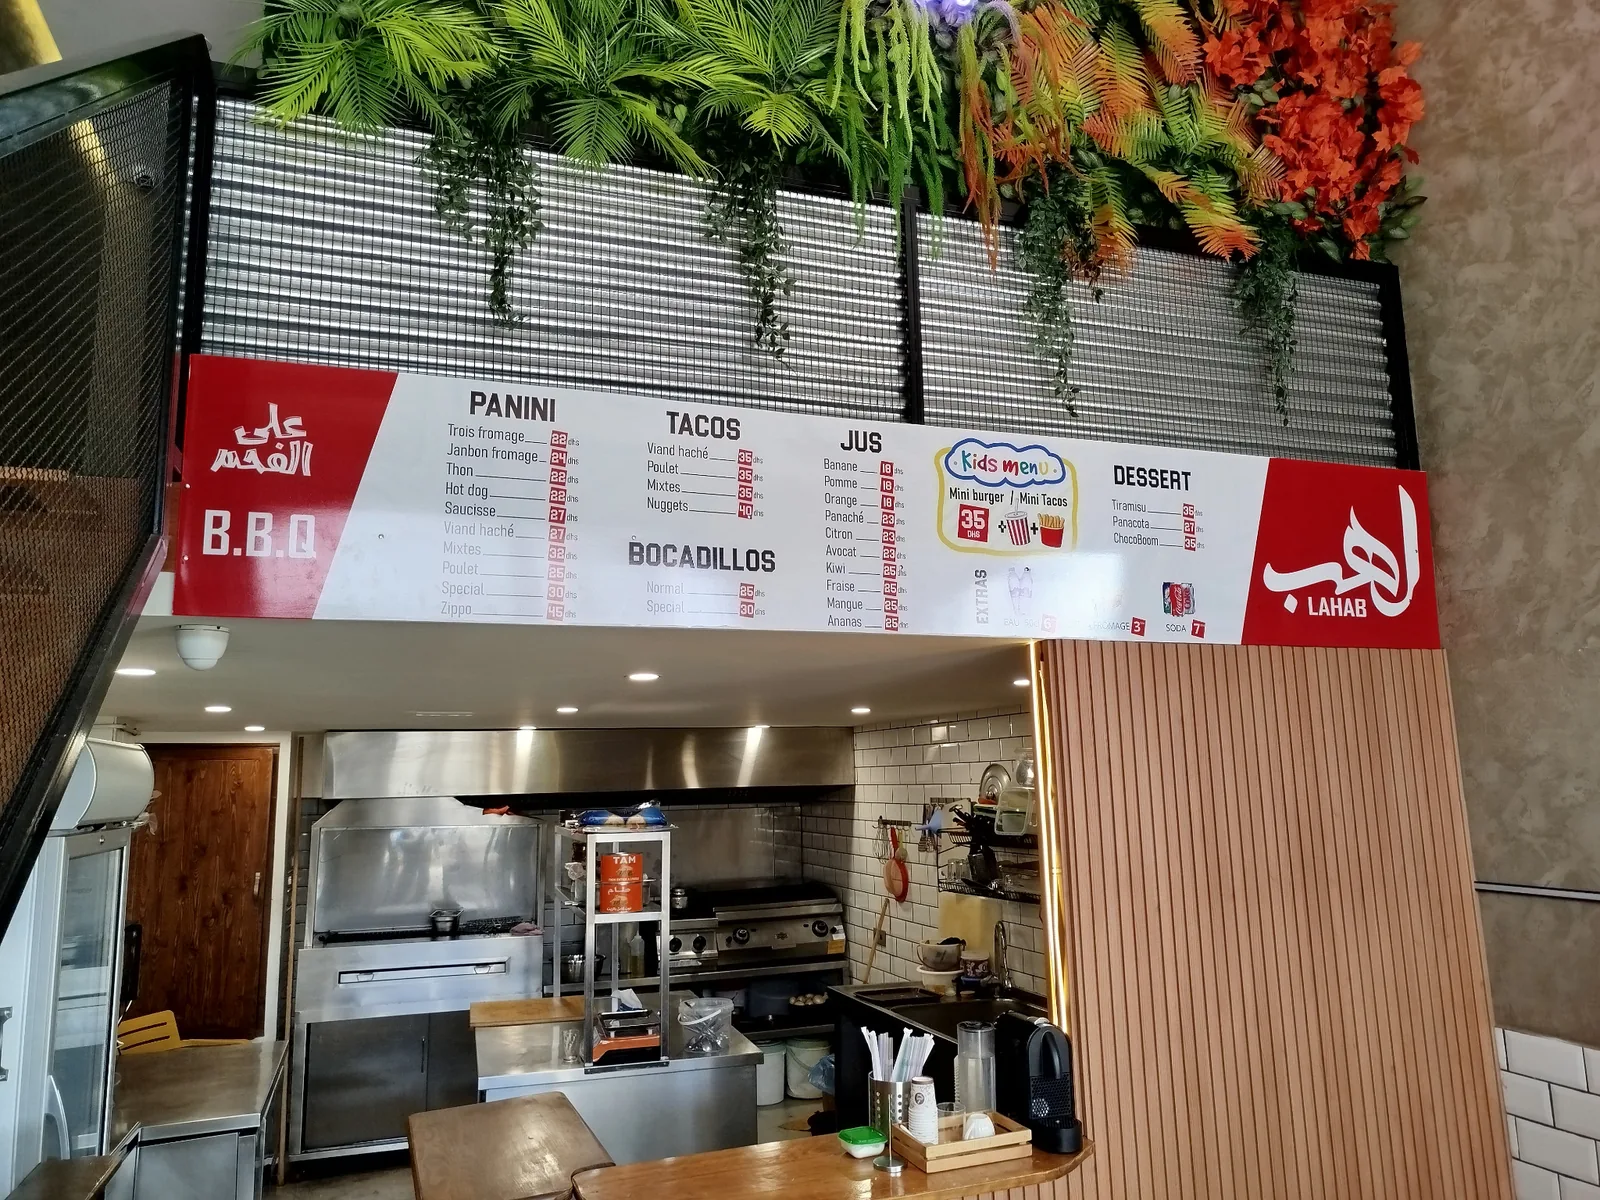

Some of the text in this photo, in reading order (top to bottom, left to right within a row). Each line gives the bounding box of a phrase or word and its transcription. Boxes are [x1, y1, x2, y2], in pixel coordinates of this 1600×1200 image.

[469, 390, 556, 422] PANINI
[232, 402, 306, 445] على
[666, 411, 740, 440] TACOS
[448, 424, 475, 438] Trois
[478, 426, 525, 444] fromage
[551, 434, 567, 445] 22
[840, 430, 882, 454] JUS
[210, 440, 313, 476] الفحم
[447, 444, 579, 465] Janbon fromage 24 dhs
[647, 442, 675, 456] Viand
[678, 447, 708, 459] haché
[738, 452, 752, 462] 35
[961, 450, 997, 473] Kids
[446, 463, 579, 484] Thon 22 dhs
[647, 461, 763, 482] Poulet 35 dhs
[823, 458, 857, 472] Banane
[882, 464, 891, 473] 18
[824, 476, 857, 489] Pomme
[883, 481, 892, 490] 18
[1114, 465, 1191, 491] DESSERT
[446, 483, 578, 503] Hot dog 22 dhs
[647, 479, 680, 492] Mixtes
[739, 488, 752, 498] 35
[949, 487, 970, 500] Mini
[973, 489, 1005, 505] burger
[1020, 492, 1039, 505] Mini
[1041, 494, 1068, 507] Tacos
[647, 497, 688, 513] Nuggets
[739, 505, 752, 516] 40
[825, 493, 857, 509] Orange
[884, 498, 892, 507] 18
[1112, 499, 1146, 512] Tiramisu
[1183, 506, 1194, 515] 35
[445, 502, 578, 522] Saucisse 27 dhs
[825, 510, 864, 524] Panaché
[883, 515, 894, 524] 23
[961, 509, 985, 530] 35
[202, 509, 317, 558] B.B.Q
[444, 522, 578, 541] Viand haché 27 dhs
[1113, 516, 1149, 529] Panacota
[1184, 522, 1195, 532] 27
[825, 527, 853, 540] Citron
[883, 532, 895, 542] 23
[967, 530, 980, 539] DHS
[1114, 533, 1159, 546] ChocoBoom
[1185, 539, 1195, 549] 35
[443, 541, 577, 560] Mixtes 32 dhs
[628, 542, 776, 572] BOCADILLOS
[826, 545, 856, 557] Avocat
[883, 549, 895, 558] 23
[1263, 485, 1420, 617] لهب
[442, 561, 577, 580] Poulet 25 dhs
[826, 562, 846, 574] Kiwi
[884, 566, 896, 576] 25
[441, 582, 577, 599] Special 30 dhs
[646, 581, 685, 594] Normal
[827, 579, 854, 592] Fraise
[884, 583, 896, 593] 25
[827, 597, 863, 612] Mangue
[885, 601, 897, 610] 25
[975, 569, 988, 624] EXTRAS
[440, 602, 472, 617] Zippo
[548, 606, 563, 618] 45
[646, 600, 685, 614] Special
[740, 605, 754, 615] 30
[1308, 597, 1367, 617] LAHAB
[828, 614, 862, 627] Ananas
[886, 618, 898, 627] 25
[1134, 622, 1140, 631] 3
[1166, 624, 1200, 635] SODA 7
[613, 856, 636, 864] TAM
